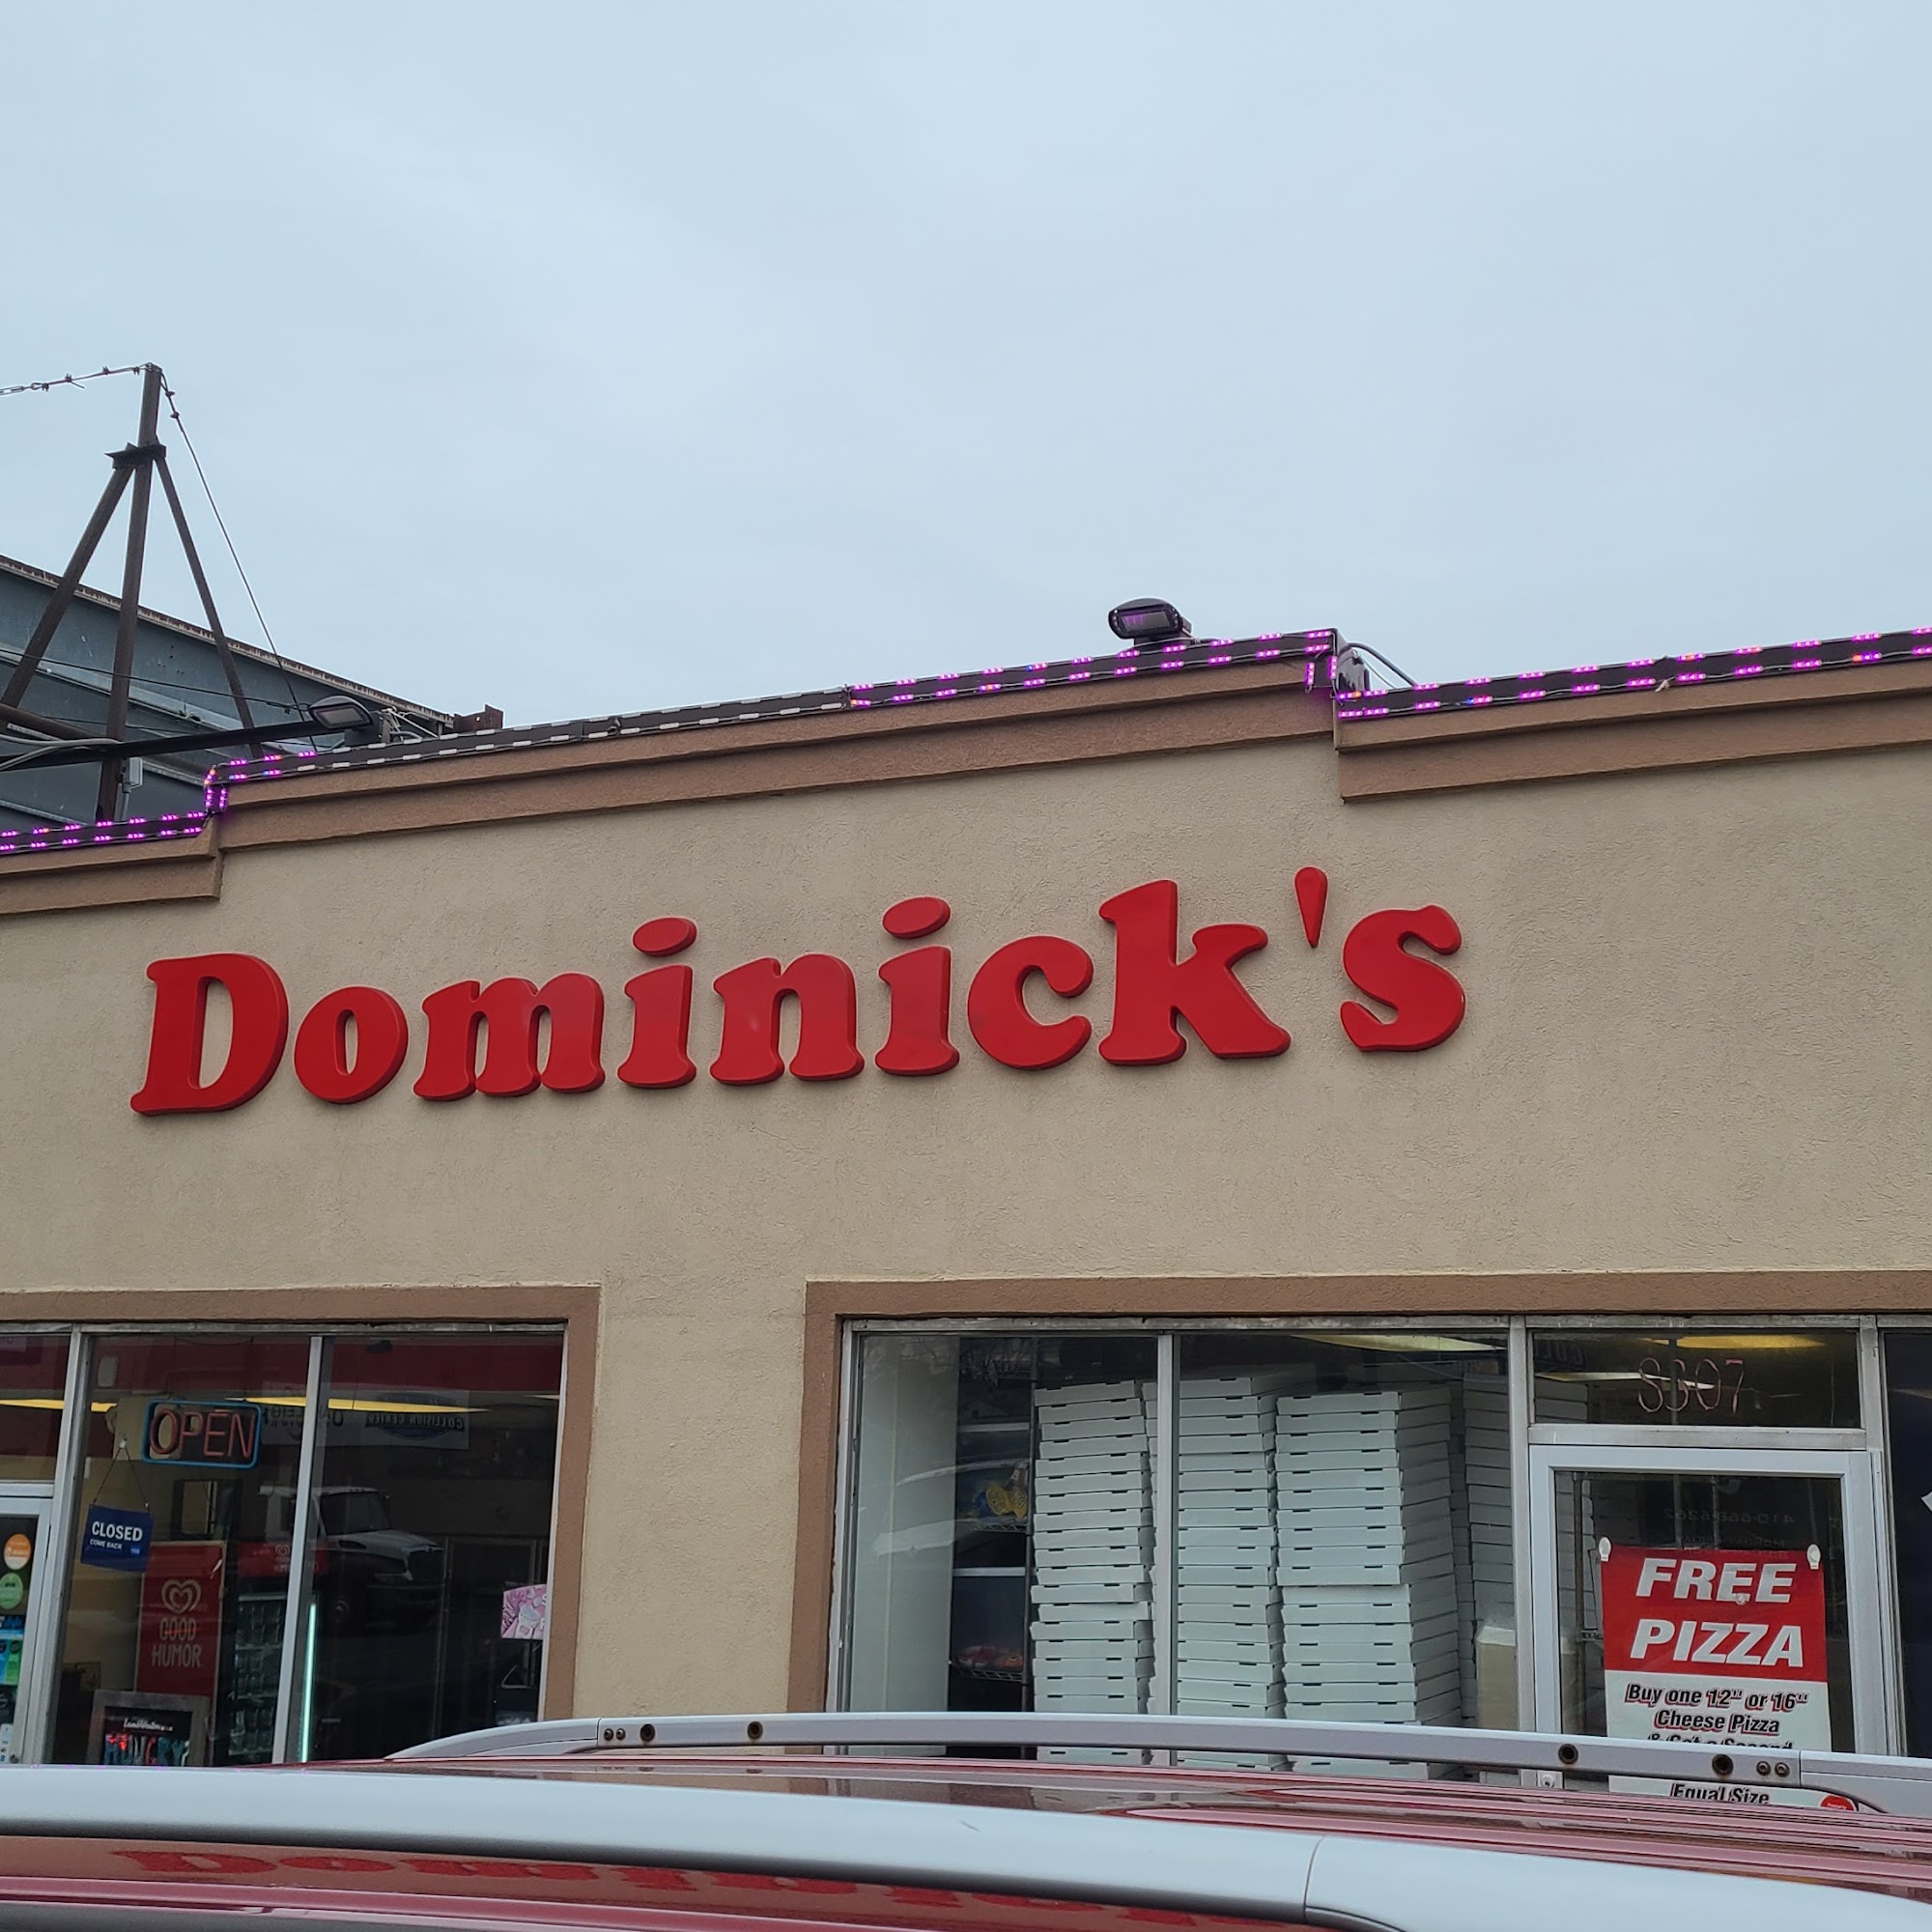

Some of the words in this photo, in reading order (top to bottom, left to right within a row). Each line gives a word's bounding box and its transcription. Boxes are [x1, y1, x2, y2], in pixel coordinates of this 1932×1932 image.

[131, 867, 1463, 1111] Dominick's
[1638, 1357, 1743, 1413] 8307
[149, 1408, 256, 1460] OPEN
[92, 1520, 143, 1542] CLOSED
[89, 1539, 106, 1548] COME
[106, 1542, 123, 1550] BACK
[1635, 1557, 1797, 1604] FREE
[159, 1617, 197, 1641] GOOD
[152, 1642, 202, 1668] HUMOR
[1630, 1618, 1804, 1668] PIZZA
[1625, 1684, 1662, 1707] Buy
[1664, 1688, 1702, 1706] one
[1745, 1691, 1769, 1710] or
[1654, 1709, 1725, 1732] Cheese
[1727, 1714, 1780, 1736] Pizza
[1729, 1787, 1770, 1804] Size
